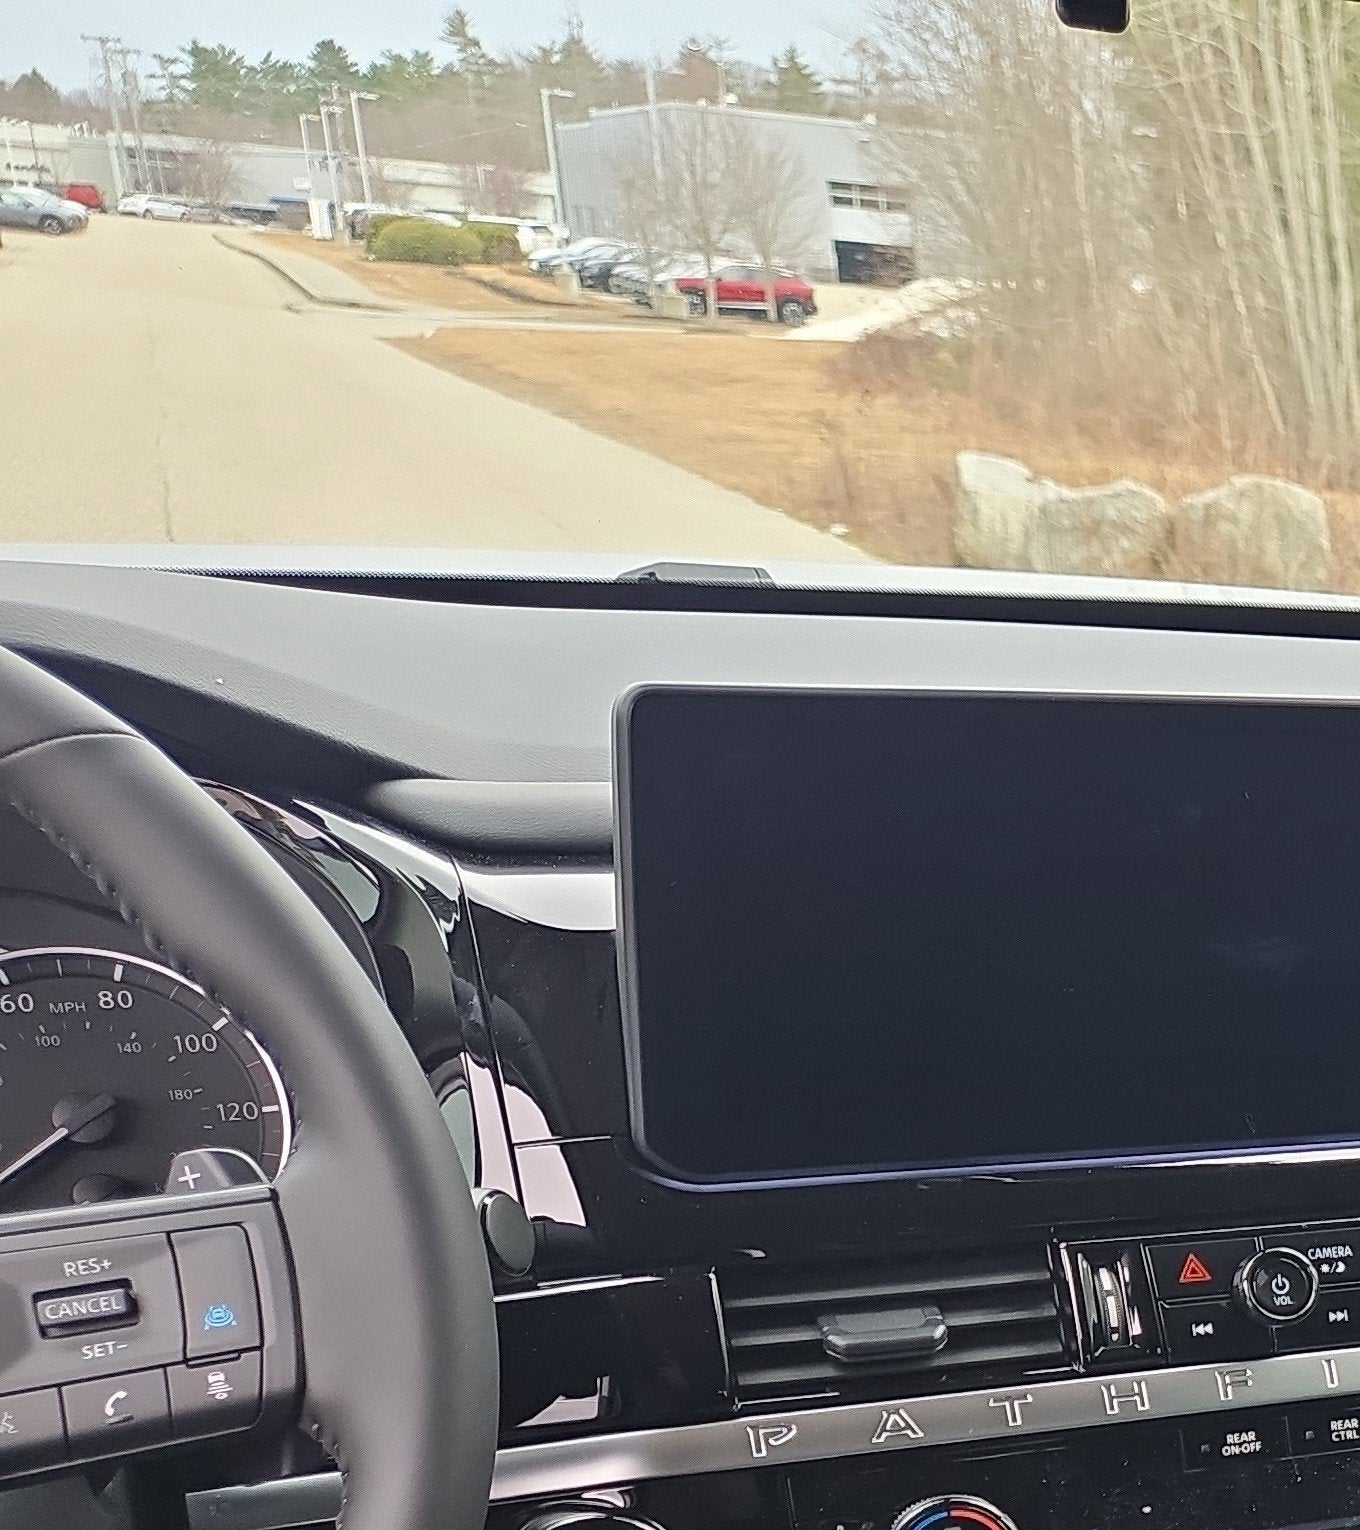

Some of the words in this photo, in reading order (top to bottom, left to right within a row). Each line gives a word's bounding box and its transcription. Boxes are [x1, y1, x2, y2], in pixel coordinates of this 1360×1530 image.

[0, 993, 34, 1014] 60
[50, 1001, 86, 1014] MPH
[98, 990, 133, 1009] 80
[35, 1035, 61, 1048] 100
[116, 1042, 142, 1053] 140
[173, 1033, 218, 1053] 100
[168, 1089, 193, 1101] 180
[216, 1102, 259, 1122] 120
[1307, 1245, 1353, 1260] CAMERA
[63, 1257, 113, 1278] RES+
[44, 1296, 123, 1319] CANCEL
[1273, 1295, 1294, 1307] VOL
[1330, 1418, 1359, 1431] REAR
[1226, 1431, 1256, 1445] REAR
[1331, 1429, 1360, 1442] CTRL
